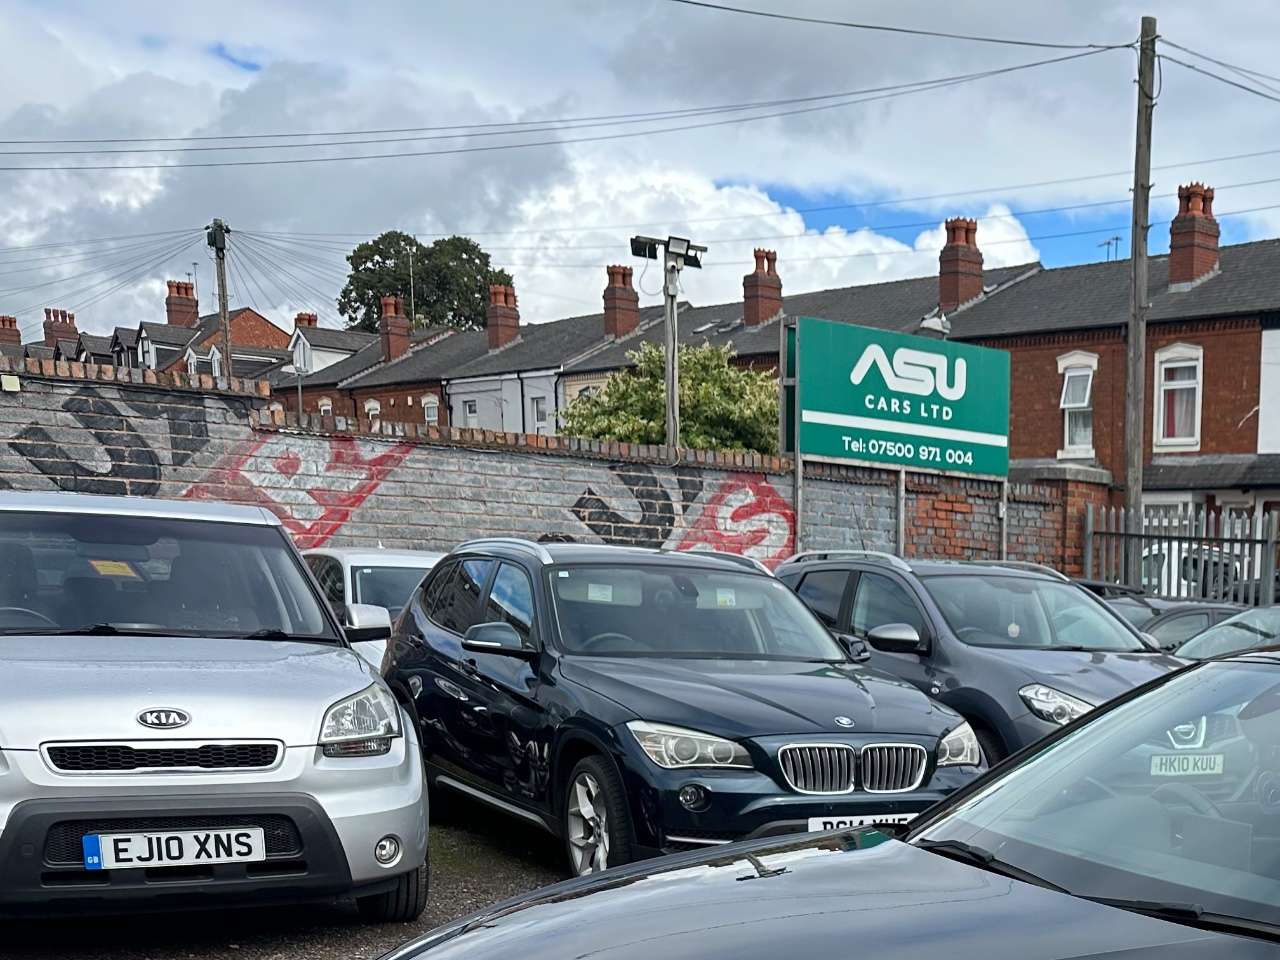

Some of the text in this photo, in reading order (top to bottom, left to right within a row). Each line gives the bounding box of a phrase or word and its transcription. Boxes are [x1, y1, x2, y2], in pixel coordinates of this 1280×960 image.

[850, 343, 967, 401] ASU
[865, 394, 953, 420] CARS LTD
[842, 436, 973, 465] Tel: 07500 971 004
[146, 711, 185, 724] KIA
[1160, 757, 1190, 772] HK10
[87, 856, 99, 864] GB
[113, 832, 252, 863] EJ10 XNS
